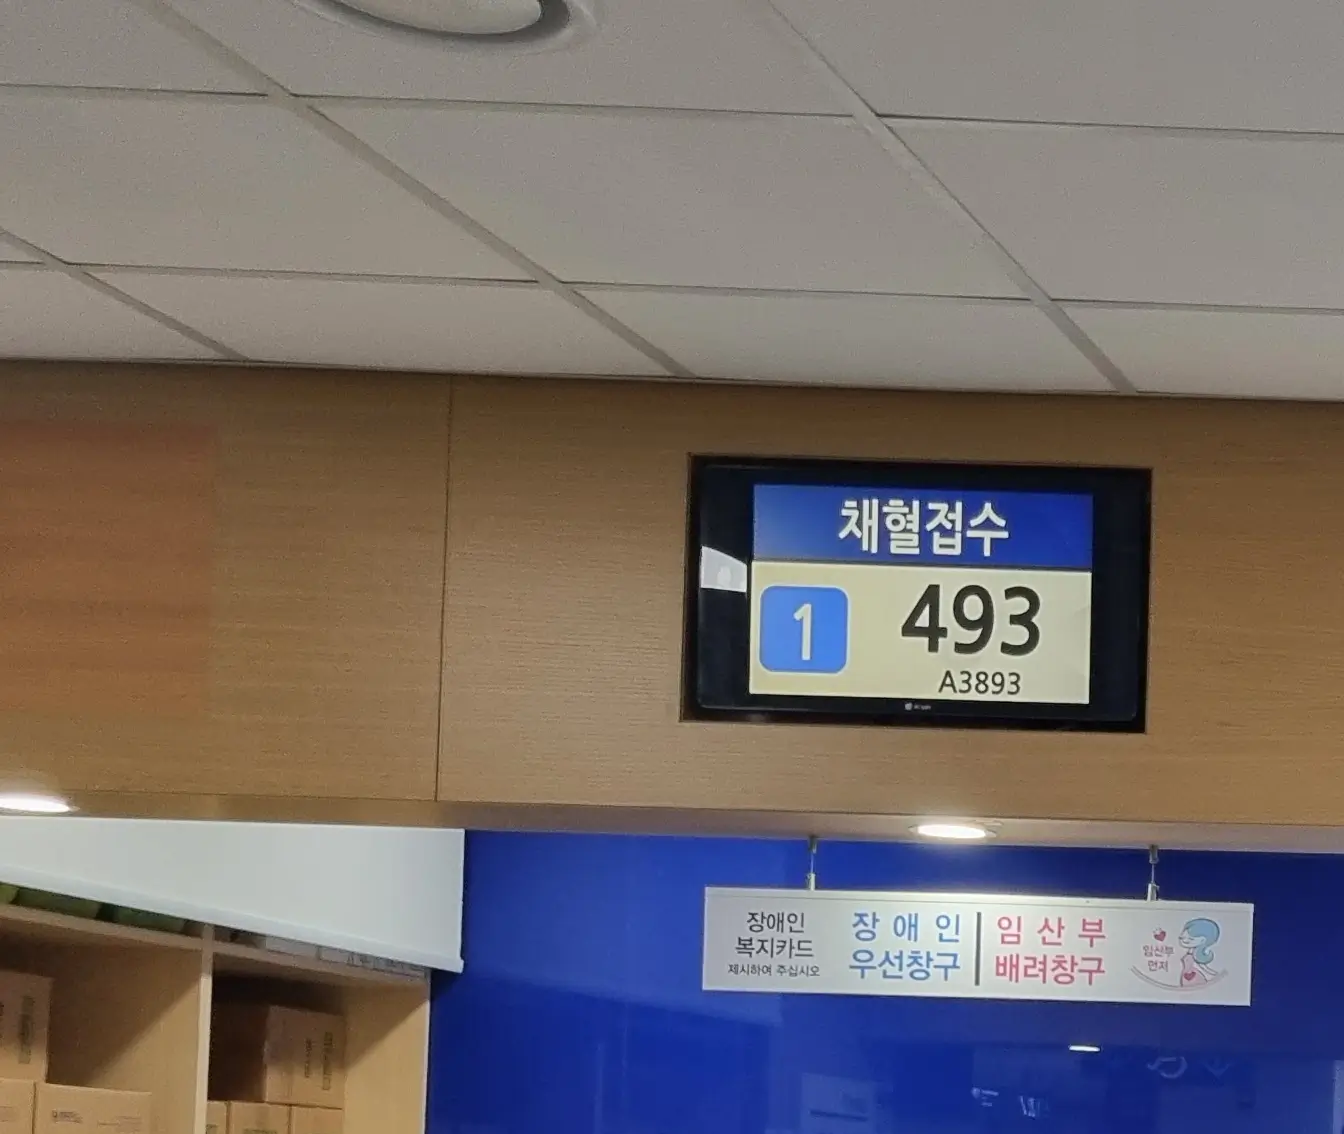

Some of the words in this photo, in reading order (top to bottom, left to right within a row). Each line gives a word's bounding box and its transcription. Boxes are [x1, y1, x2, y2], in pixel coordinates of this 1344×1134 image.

[838, 498, 1010, 557] 채혈접수
[793, 603, 813, 661] 1
[901, 583, 1041, 656] 493
[938, 670, 1021, 695] A3893
[747, 912, 804, 933] 장애인
[852, 911, 960, 943] 장애인
[997, 915, 1106, 948] 임산부
[735, 936, 814, 959] 복지카드
[1143, 945, 1174, 957] 임산부
[728, 964, 772, 977] 제시하여
[776, 965, 820, 977] 주십시오
[849, 949, 961, 981] 우선창구
[995, 954, 1106, 986] 배려창구
[1148, 960, 1169, 972] 먼저
